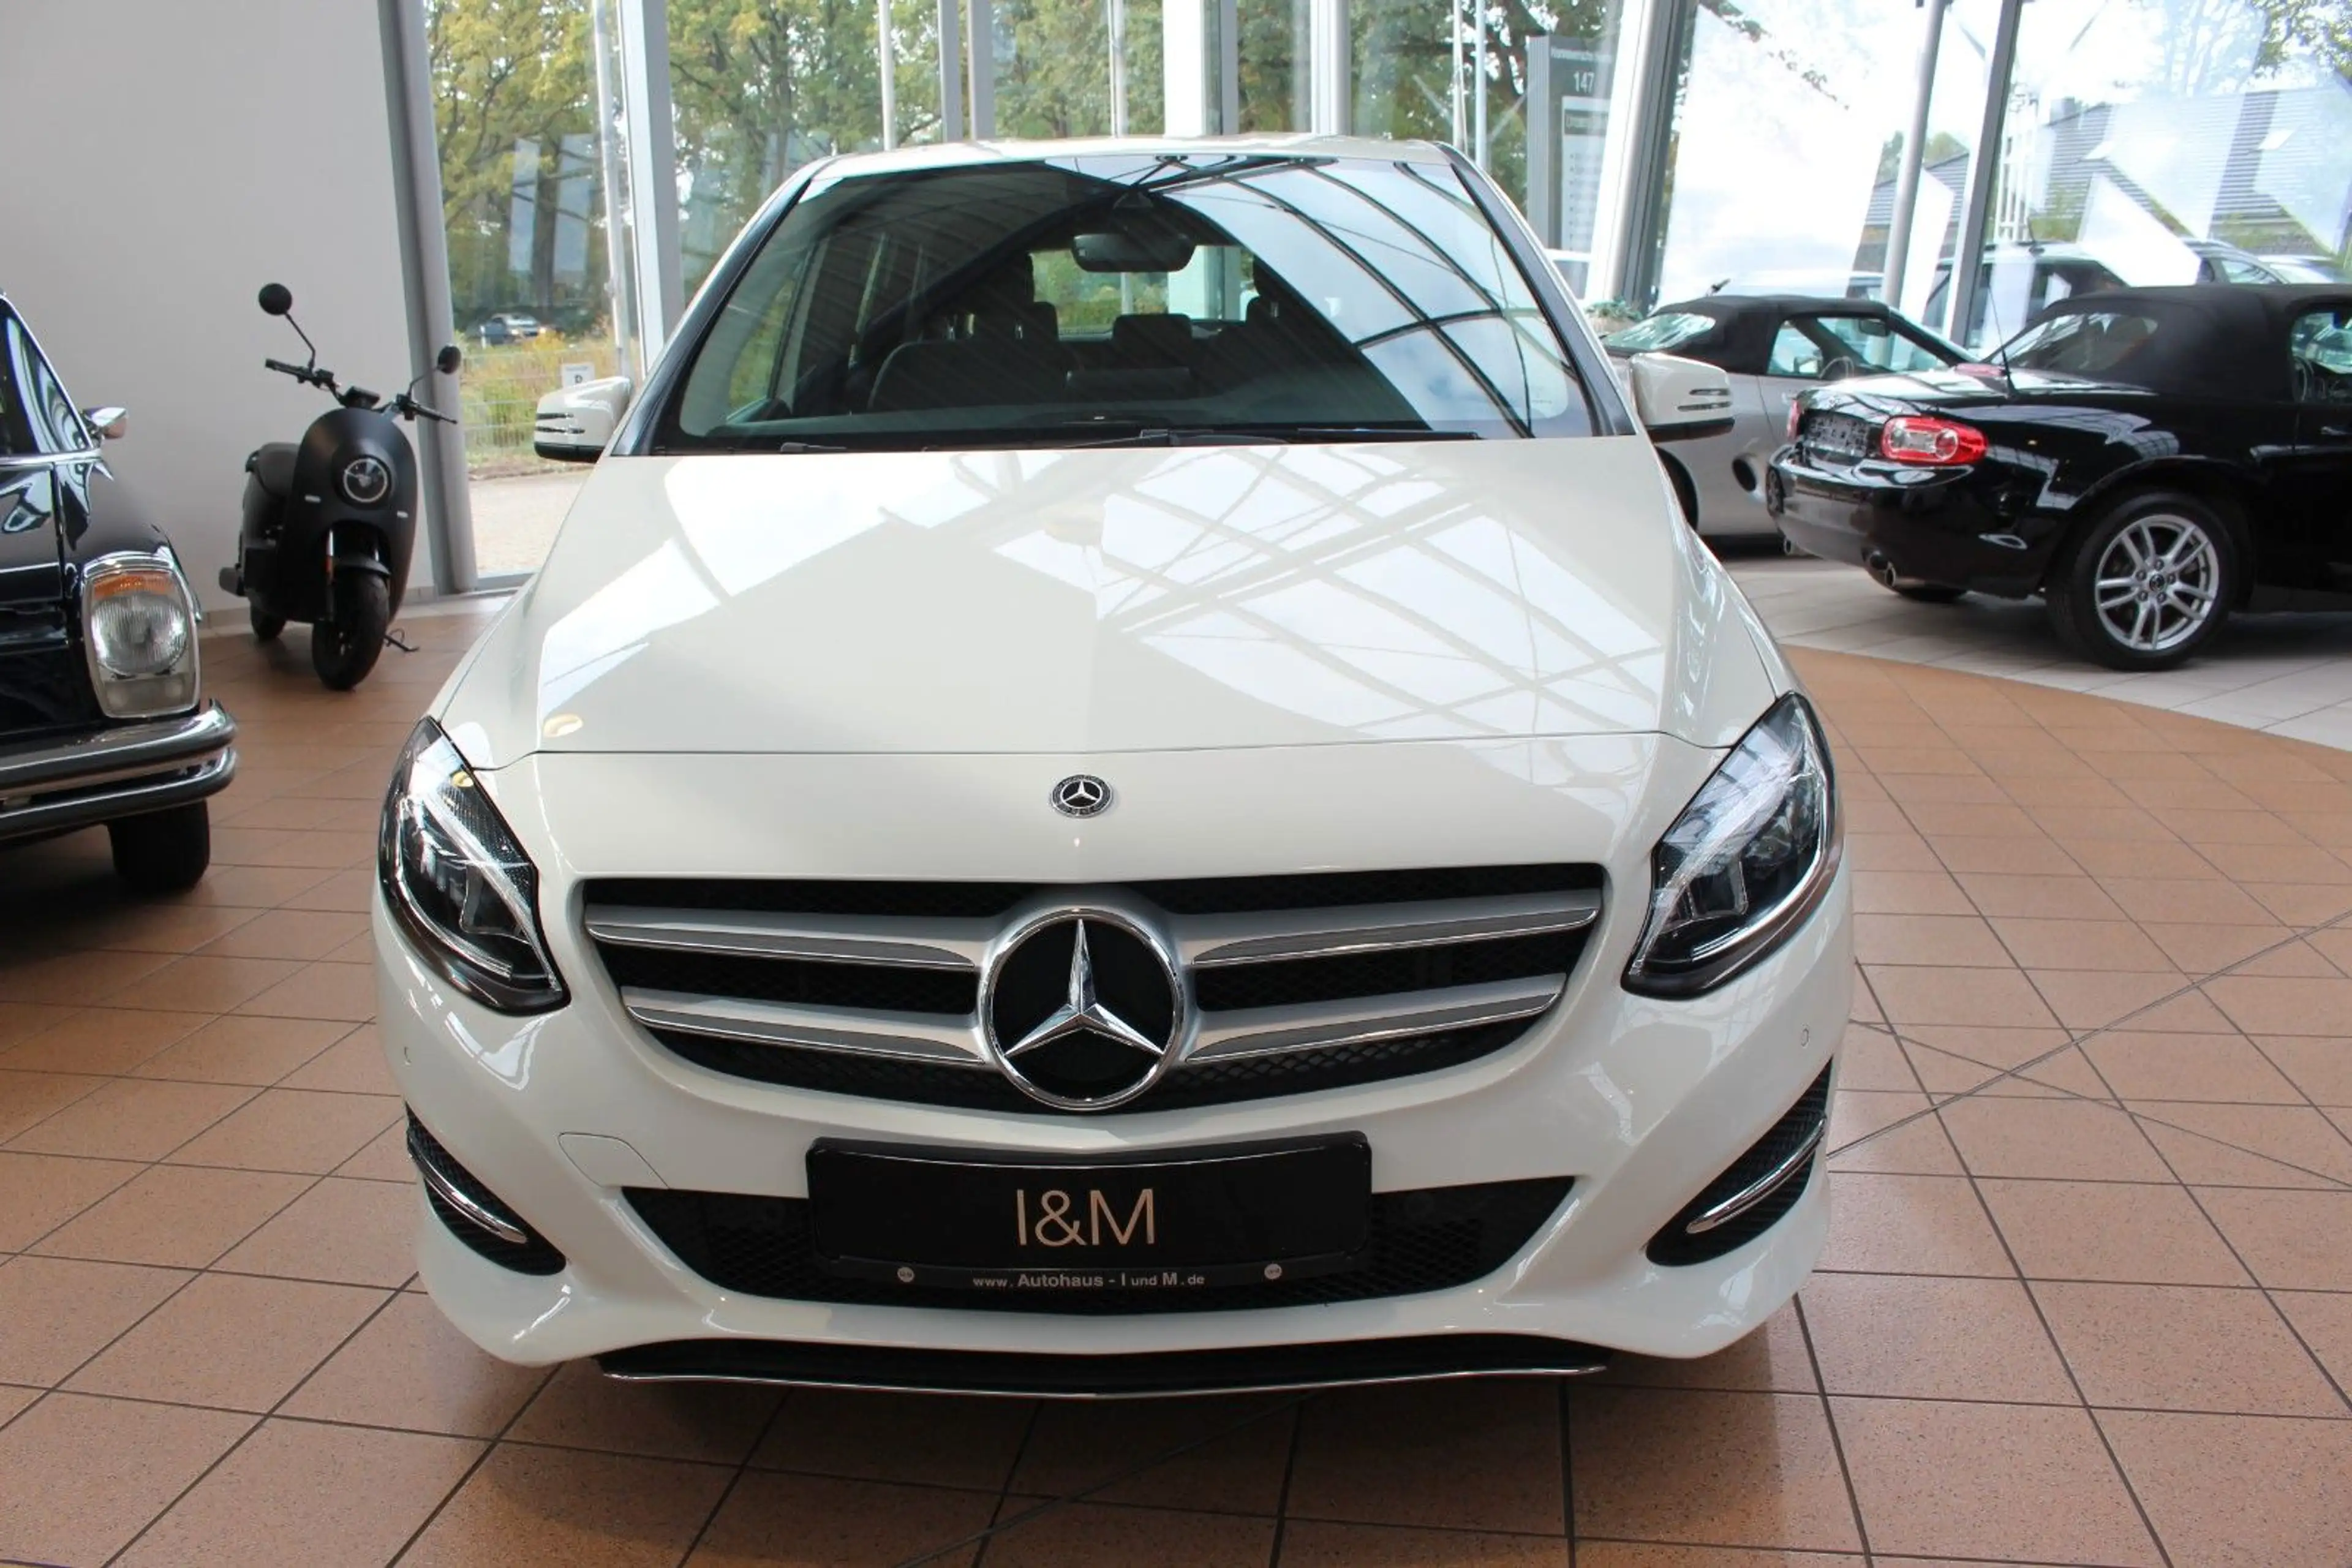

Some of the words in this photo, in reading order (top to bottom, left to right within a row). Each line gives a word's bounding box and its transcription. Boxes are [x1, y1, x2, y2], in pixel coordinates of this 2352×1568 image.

[1574, 71, 1594, 93] 147
[1017, 1188, 1155, 1246] I&M
[1121, 1272, 1126, 1286] I
[1131, 1275, 1157, 1286] und
